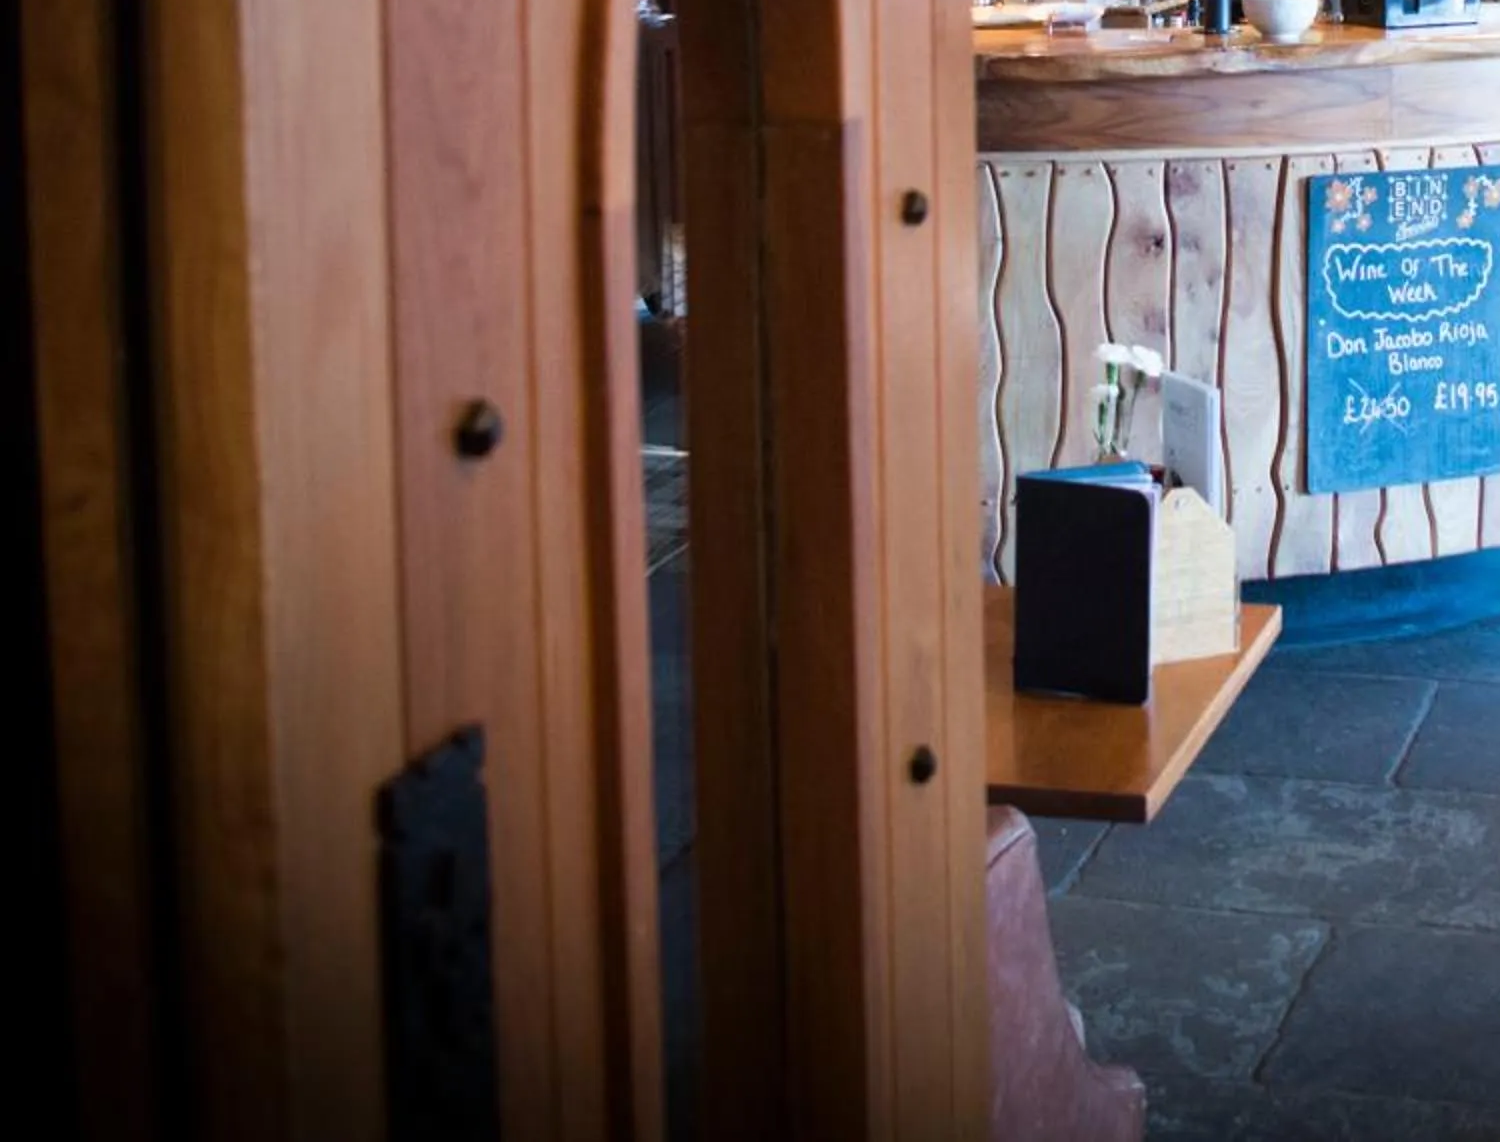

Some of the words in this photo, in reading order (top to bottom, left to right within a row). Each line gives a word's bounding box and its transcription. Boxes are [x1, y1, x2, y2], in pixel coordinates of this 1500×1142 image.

[1395, 178, 1442, 197] BIN
[1395, 199, 1442, 217] END
[1335, 256, 1387, 281] Wine
[1402, 258, 1419, 277] Of
[1431, 254, 1468, 277] The
[1388, 283, 1436, 304] Week
[1327, 332, 1367, 359] Don
[1374, 328, 1433, 352] Jacobo
[1440, 321, 1488, 346] Rioja
[1434, 381, 1499, 410] £19.95
